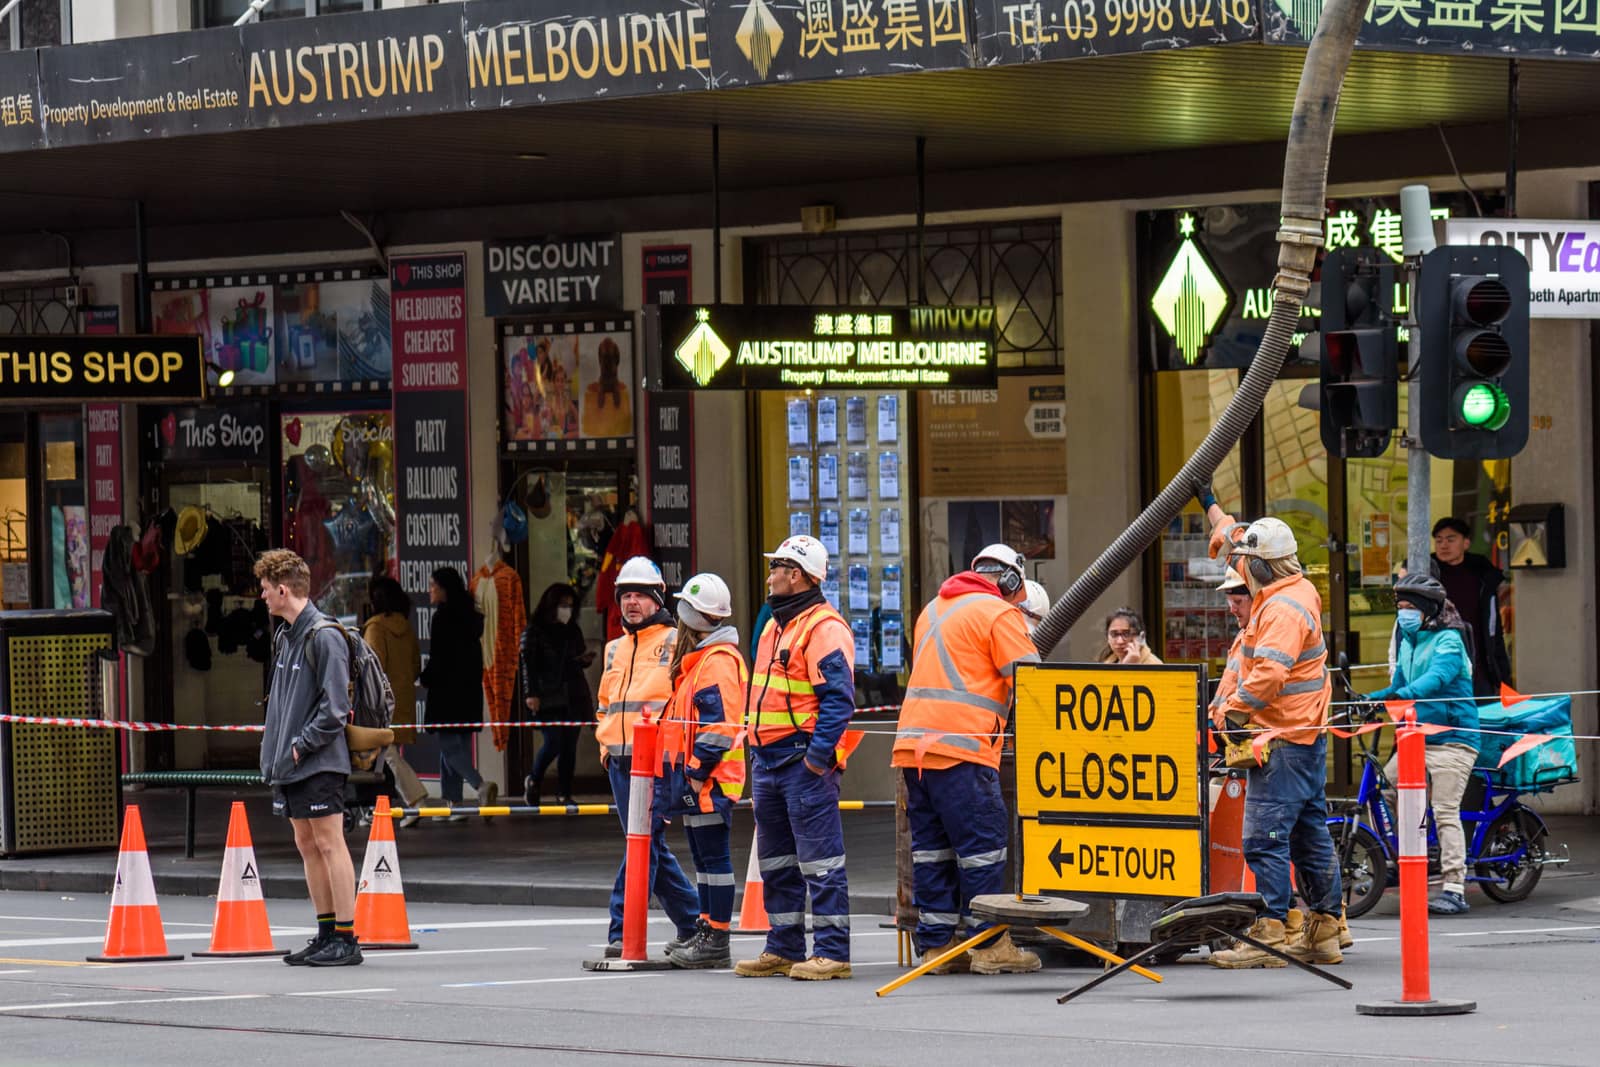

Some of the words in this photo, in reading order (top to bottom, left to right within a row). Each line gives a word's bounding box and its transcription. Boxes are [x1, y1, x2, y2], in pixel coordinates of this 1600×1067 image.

[796, 0, 967, 58] 澳盛集团
[1002, 3, 1059, 46] TEL:
[1064, 0, 1098, 41] 03
[1104, 0, 1175, 38] 9998
[249, 34, 444, 107] AUSTRUMP
[468, 8, 710, 88] MELBOURNE
[44, 101, 89, 126] Property
[91, 95, 166, 120] Development
[167, 95, 176, 109] &
[178, 92, 201, 110] Real
[204, 89, 239, 109] Estate
[411, 267, 434, 280] THIS
[437, 264, 462, 278] SHOP
[489, 241, 613, 273] DISCOUNT
[502, 275, 600, 305] VARIETY
[396, 296, 461, 321] MELBOURNES
[404, 329, 455, 353] CHEAPEST
[736, 341, 854, 365] AUSTRUMP
[857, 341, 987, 365] MELBOURNE
[83, 352, 183, 383] SHOP
[402, 362, 459, 387] SOUVENIRS
[781, 369, 824, 384] Property
[826, 369, 889, 384] Development
[919, 369, 949, 382] Estate
[931, 389, 957, 405] THE
[960, 388, 998, 404] TIMES
[180, 419, 216, 448] This
[219, 413, 264, 454] Shop
[659, 406, 679, 431] PARTY
[415, 419, 447, 452] PARTY
[658, 446, 682, 470] TRAVEL
[406, 466, 457, 499] BALLOONS
[654, 484, 688, 508] SOUVENIRS
[406, 513, 460, 547] COSTUMES
[662, 562, 682, 587] TOOLS
[1055, 684, 1155, 731] ROAD
[1035, 751, 1178, 801] CLOSED
[1079, 844, 1175, 880] DETOUR
